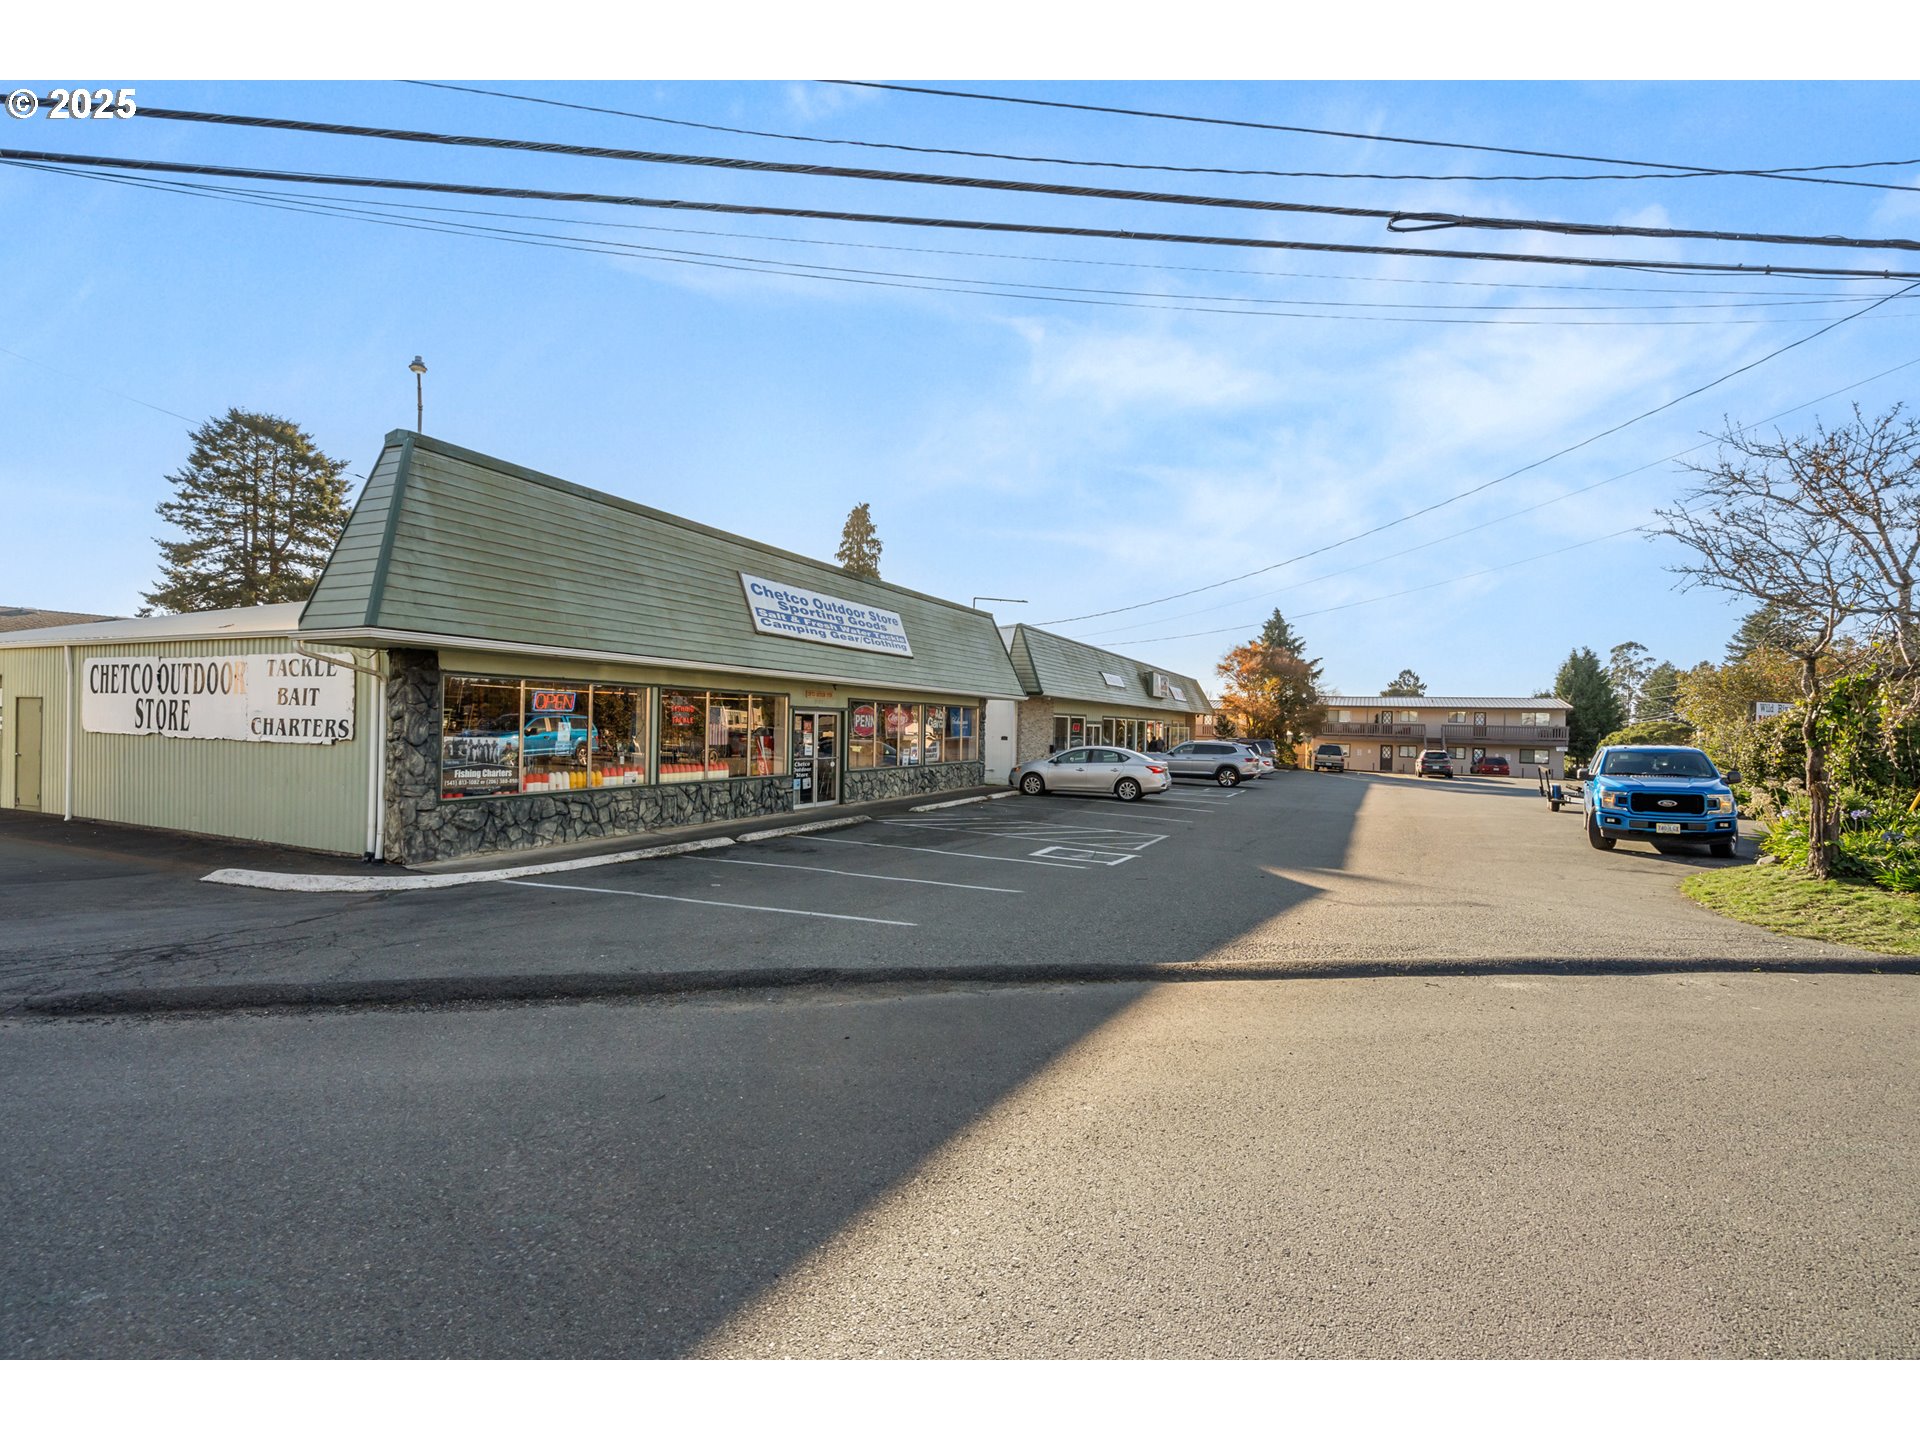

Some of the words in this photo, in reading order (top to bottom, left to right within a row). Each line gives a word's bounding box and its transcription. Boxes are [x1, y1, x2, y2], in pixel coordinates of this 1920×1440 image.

[750, 583, 809, 607] Chetco
[813, 598, 866, 619] Outdoor
[869, 610, 899, 626] Store
[758, 609, 788, 621] Salt
[791, 616, 800, 624] &
[803, 617, 838, 631] Fresh
[841, 625, 872, 638] Water
[875, 632, 906, 644] Tackle
[778, 601, 844, 625] Sporting
[847, 617, 887, 632] Goods
[760, 618, 827, 639] Camping
[830, 631, 908, 652] Gear/Clothing
[90, 663, 152, 695] CHETCO
[156, 661, 248, 695] OUTDOOR
[267, 658, 338, 678] TACKLE
[277, 687, 321, 706] BAIT
[535, 693, 575, 709] OPEN
[134, 698, 191, 732] STORE
[1760, 703, 1774, 712] Wild
[251, 717, 350, 738] CHARTERS
[672, 716, 695, 724] TACKLE
[454, 769, 481, 779] Fishing
[482, 769, 513, 778] Charters
